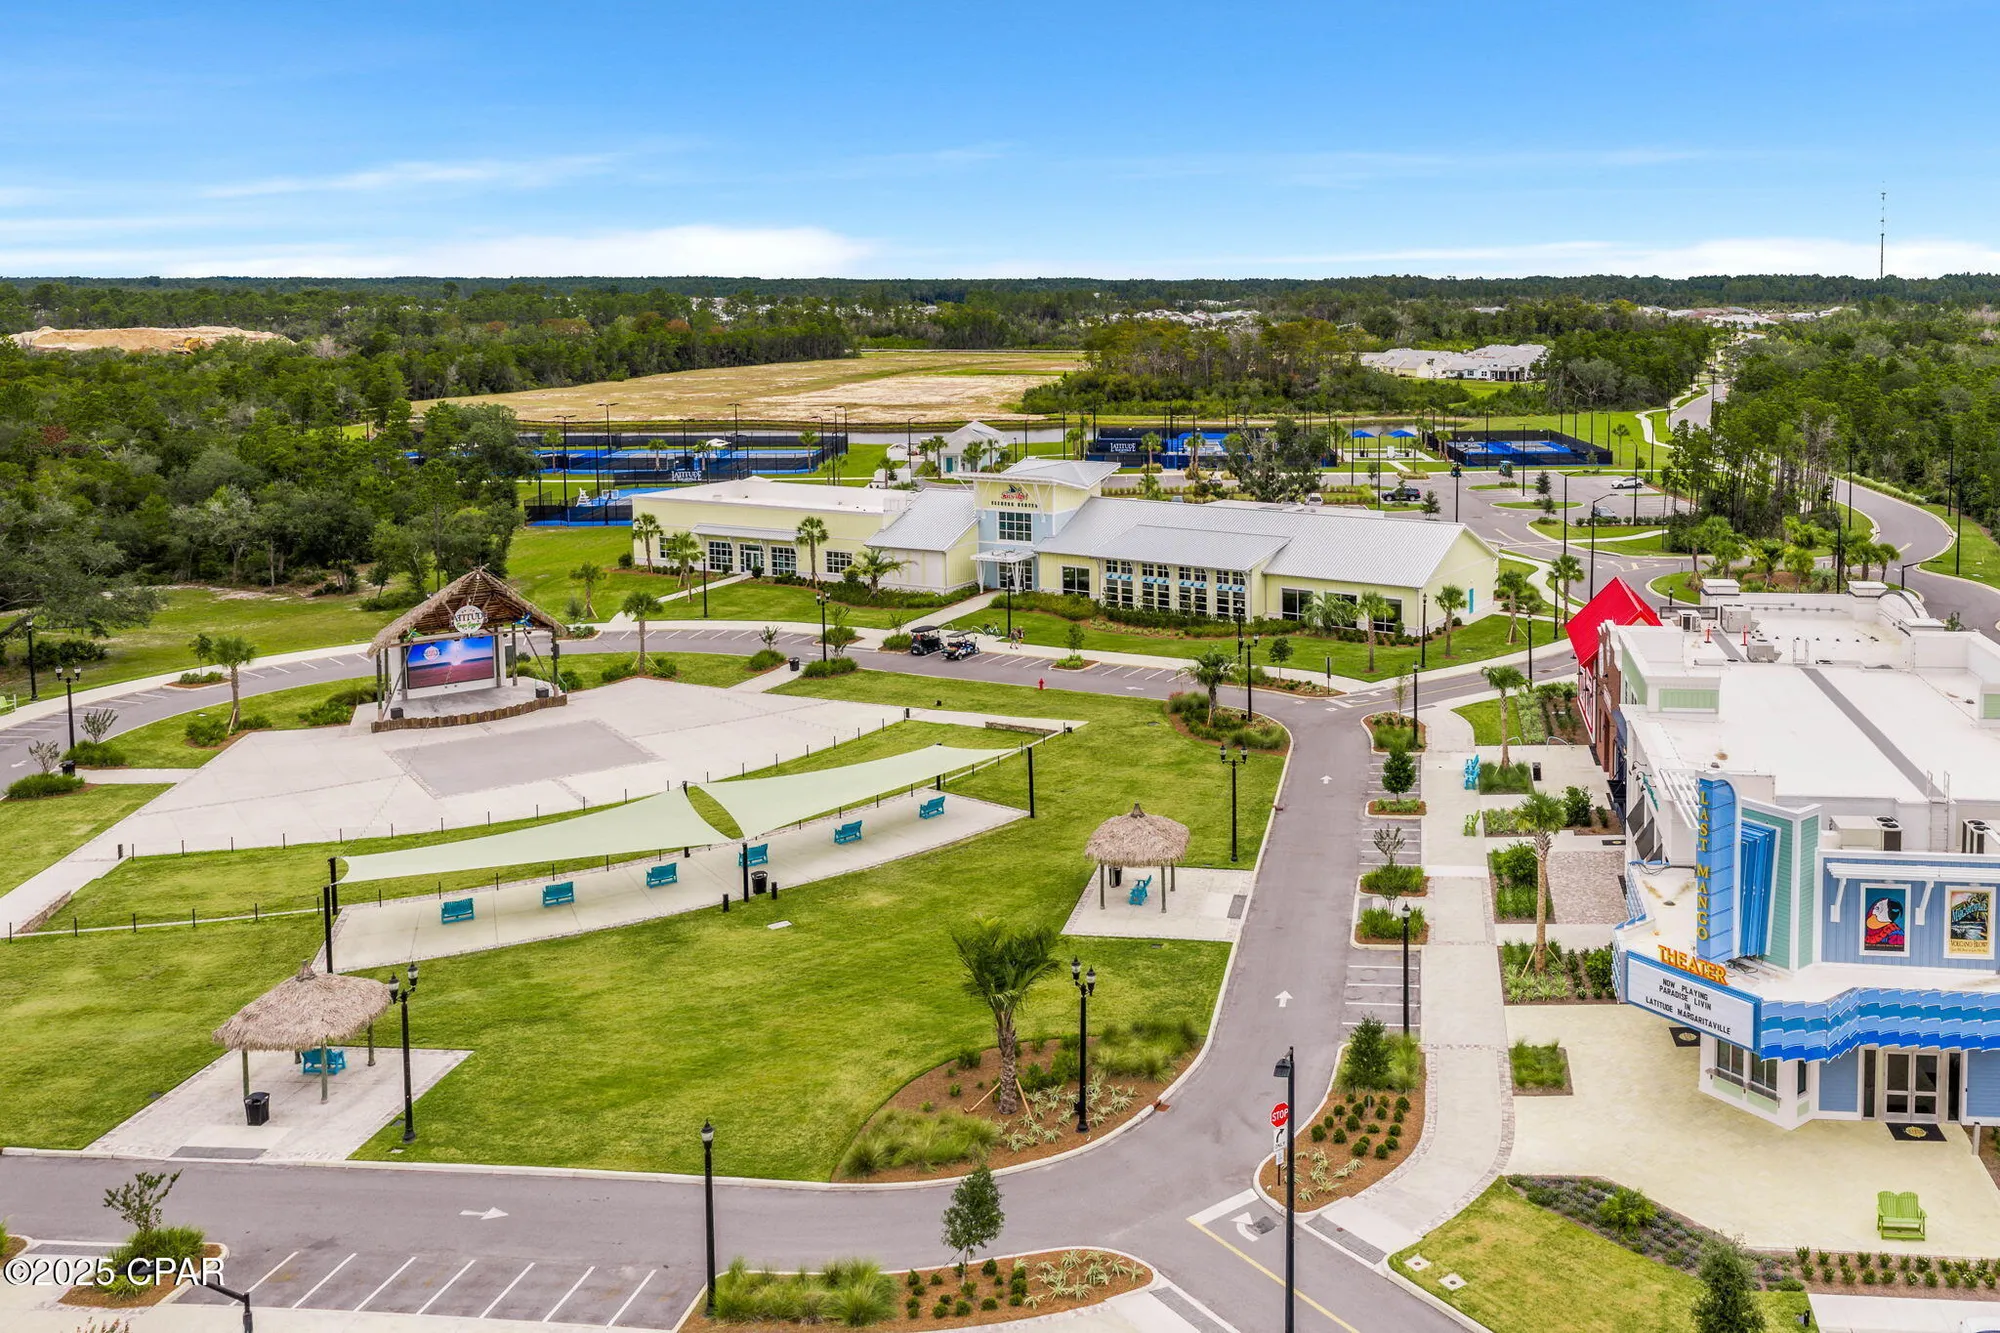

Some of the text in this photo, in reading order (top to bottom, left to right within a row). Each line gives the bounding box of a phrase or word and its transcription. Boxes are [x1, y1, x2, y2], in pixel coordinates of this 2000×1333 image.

[671, 470, 702, 481] LATITUDE
[1699, 791, 1710, 852] LAST
[1696, 863, 1710, 941] MANGO
[1657, 944, 1730, 986] THEATER
[1659, 985, 1712, 1011] PARADISE LIVIN
[1662, 978, 1708, 1001] NOW PLAYING
[1645, 996, 1731, 1036] LATITUDE MARGARITAVILLE
[1684, 1002, 1691, 1011] IN
[1272, 1109, 1288, 1122] STOP
